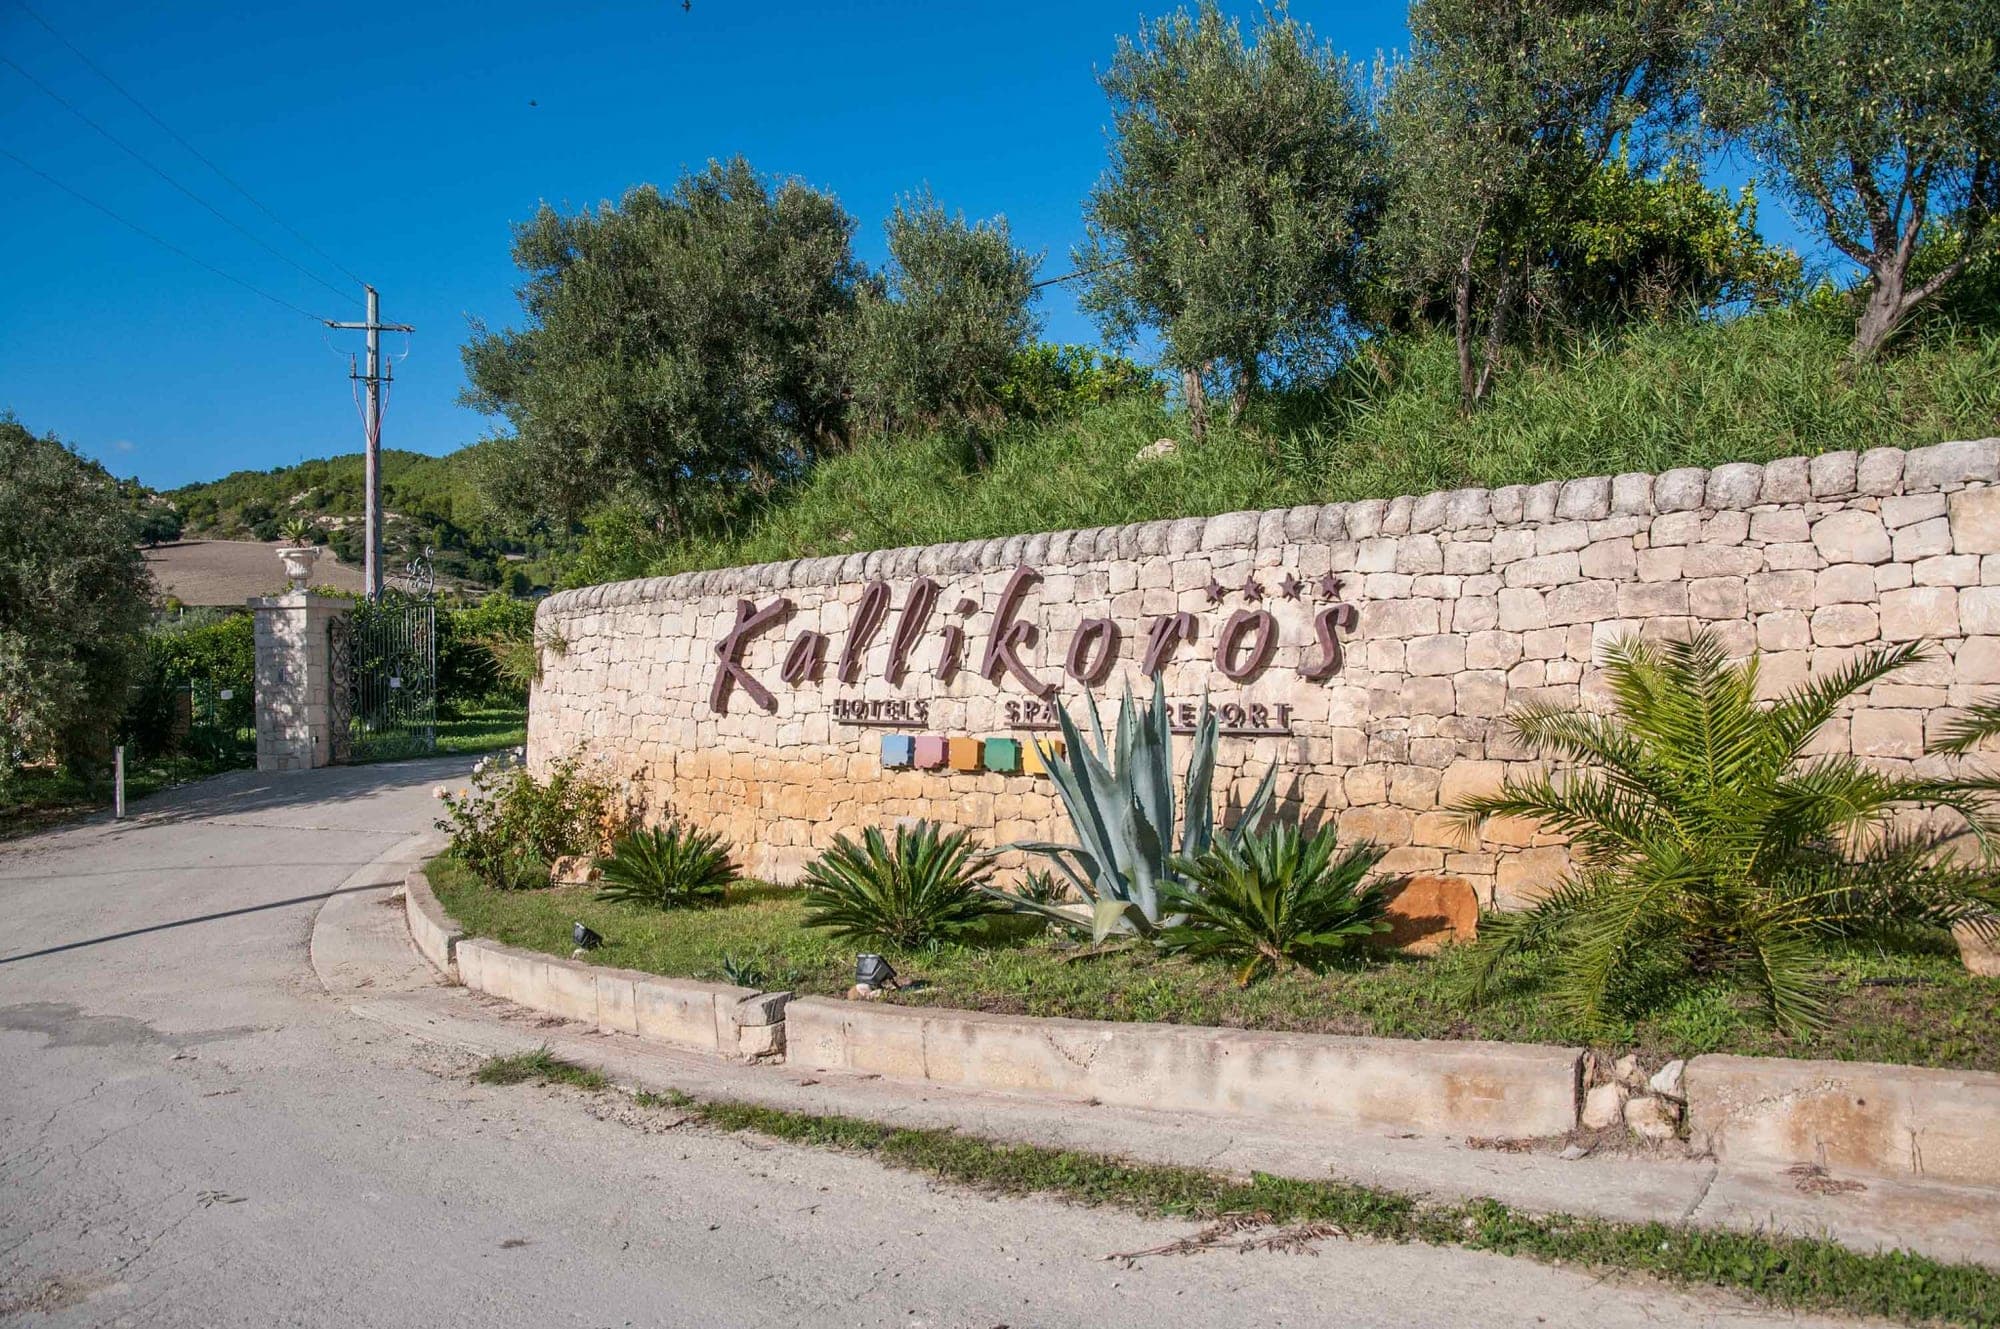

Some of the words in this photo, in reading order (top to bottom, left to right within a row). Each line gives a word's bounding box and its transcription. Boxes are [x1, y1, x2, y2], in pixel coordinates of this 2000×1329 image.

[710, 564, 1356, 715] Kallikoros
[833, 699, 929, 720] HOTELS
[1004, 700, 1059, 722] SPA
